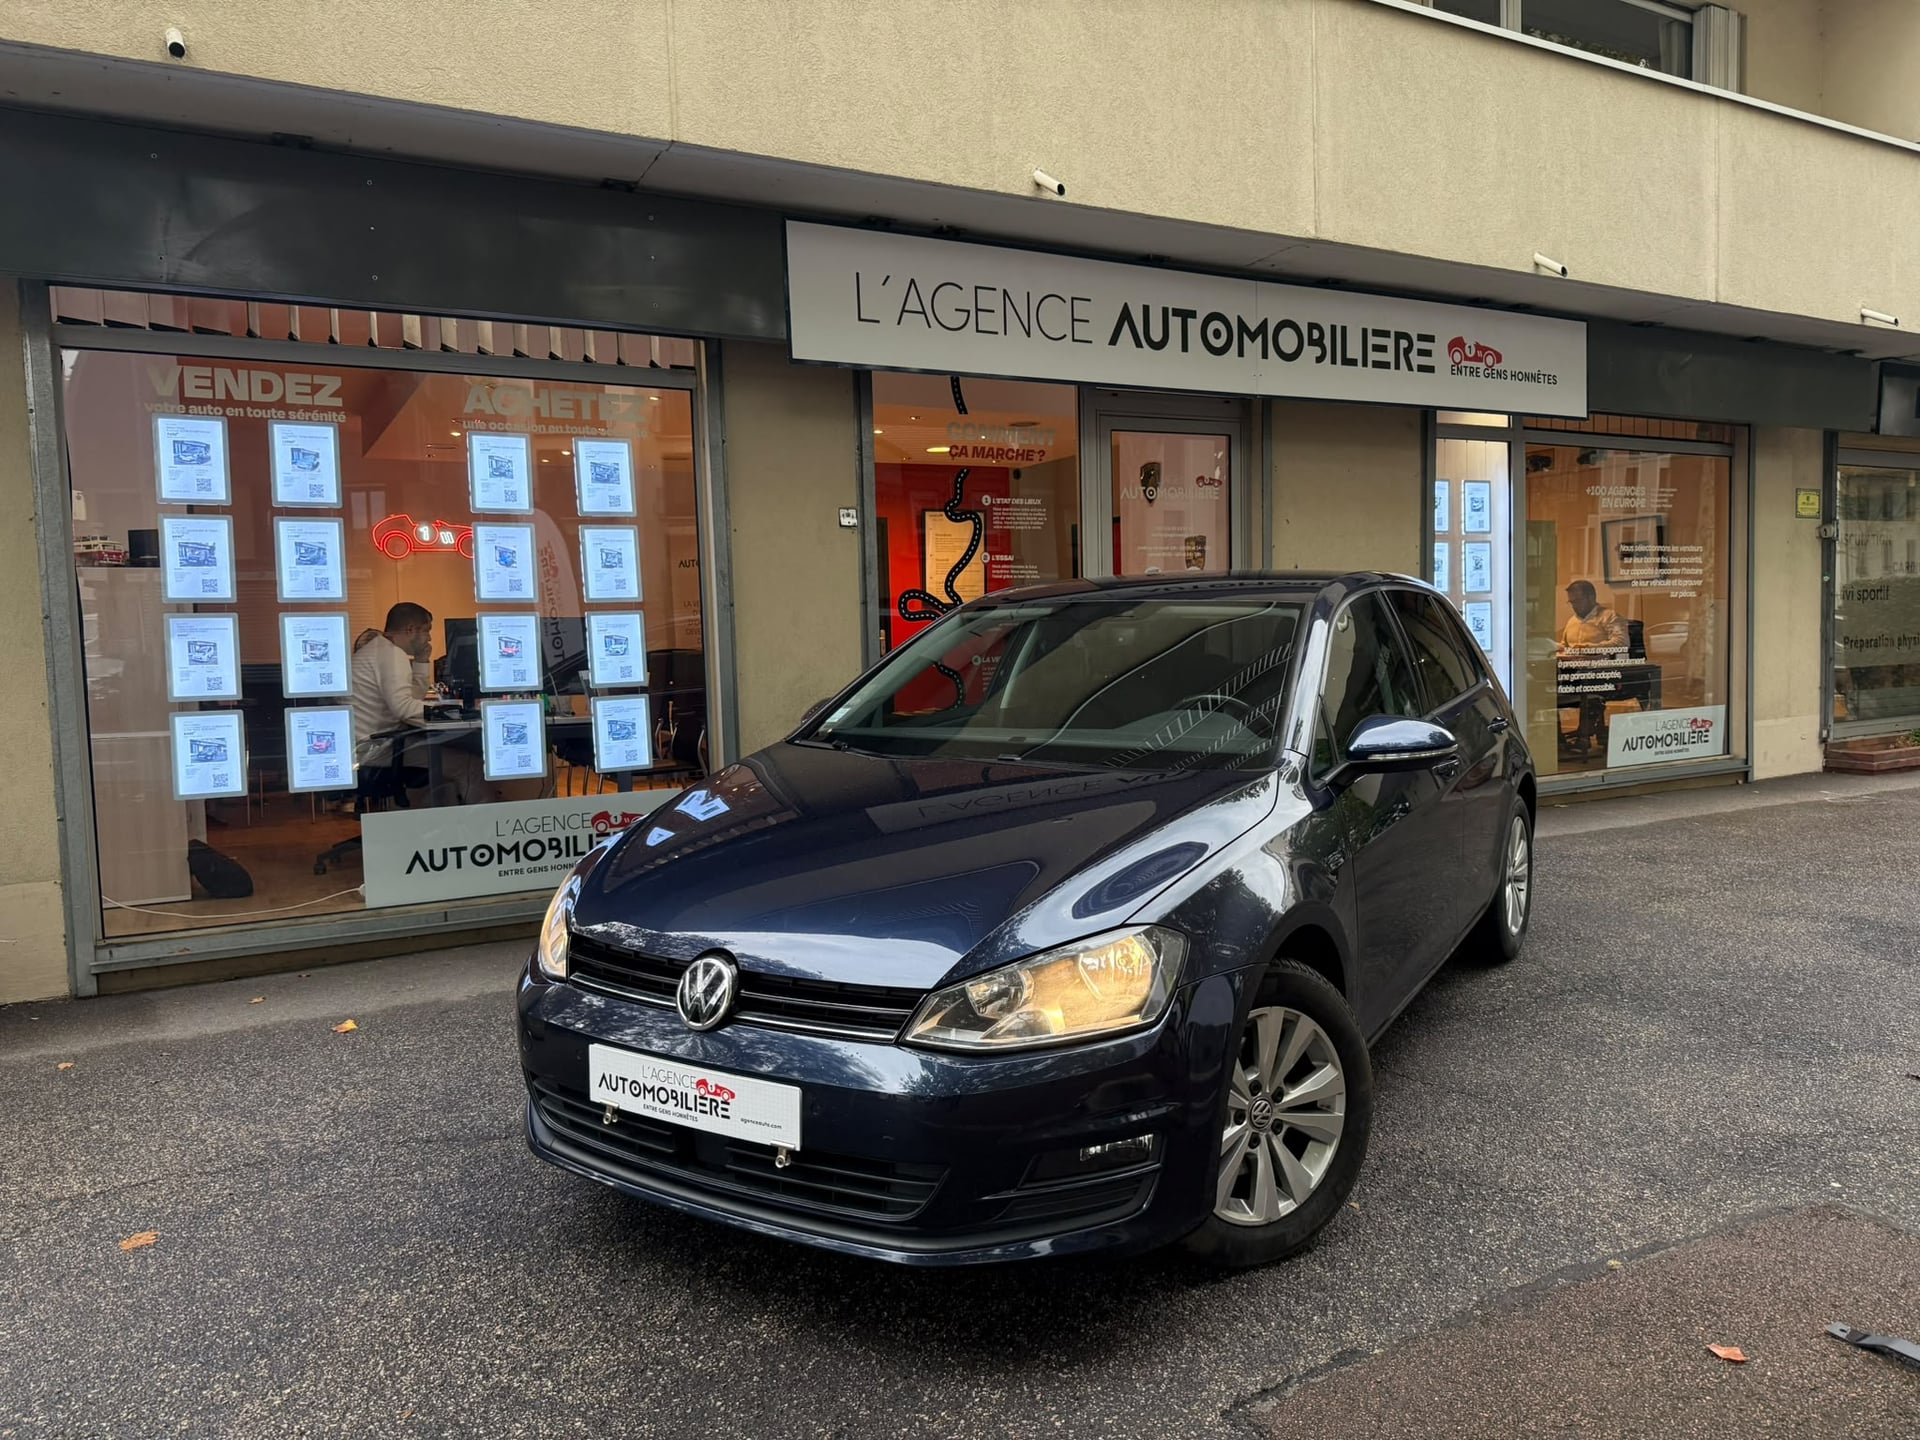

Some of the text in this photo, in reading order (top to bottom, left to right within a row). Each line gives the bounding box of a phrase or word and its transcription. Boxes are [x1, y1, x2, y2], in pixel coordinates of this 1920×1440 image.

[856, 271, 1436, 374] L'AGENCE AUTOMOBILIERE
[1450, 364, 1558, 385] ENTRE GENS HONNÊTES
[148, 364, 343, 407] VENDEZ
[144, 403, 347, 423] votre auto en toute sérénité
[463, 384, 648, 424] ACHETEZ
[462, 420, 487, 430] une
[949, 444, 969, 460] ÇA
[1607, 486, 1646, 496] AGENCES
[1602, 498, 1646, 508] EN EUROPE
[1620, 544, 1634, 552] Nous
[1856, 585, 1890, 604] sportif
[1596, 646, 1629, 655] engageons
[1843, 633, 1895, 653] Préparation
[1562, 660, 1590, 668] proposer
[1558, 673, 1569, 681] une
[1570, 671, 1596, 681] garantie
[1558, 685, 1575, 693] fiable
[1575, 685, 1582, 693] et
[1622, 729, 1710, 753] AUTOMOBILIERE
[496, 812, 592, 837] L'AGENCE
[405, 831, 610, 875] AUTOMOBILI
[498, 861, 575, 877] ENTRE GENS HONN
[642, 1064, 697, 1090] L'AGENCE
[598, 1072, 731, 1120] AUTOMOBILIERE
[642, 1103, 658, 1113] ENTRE
